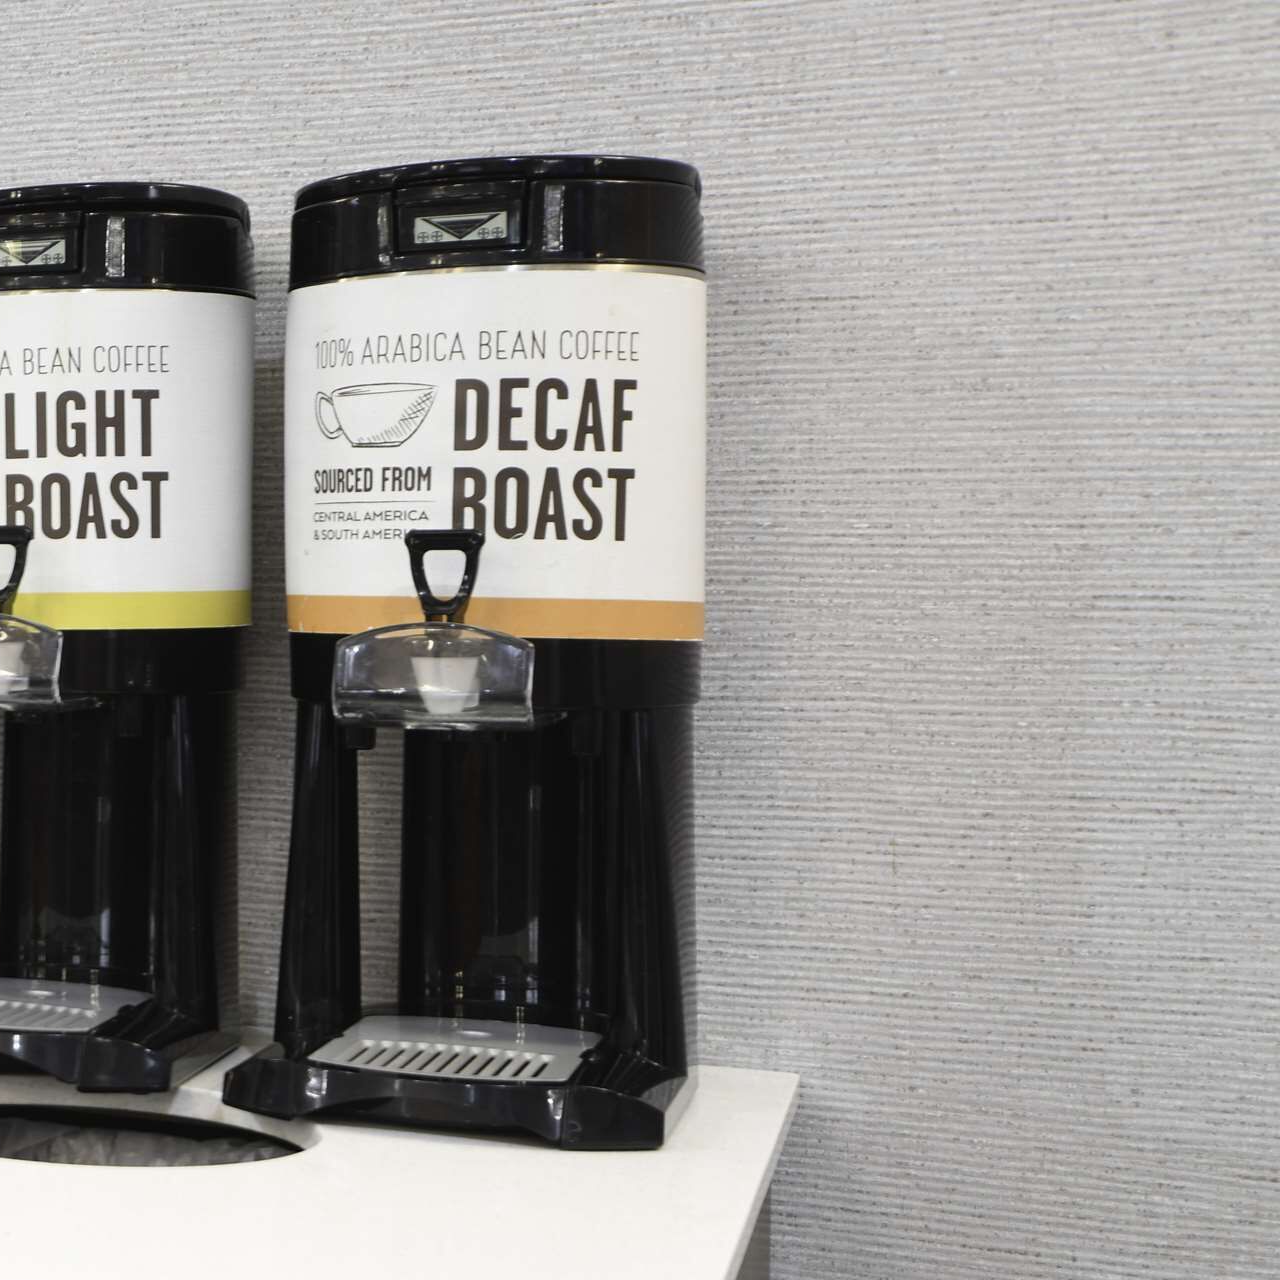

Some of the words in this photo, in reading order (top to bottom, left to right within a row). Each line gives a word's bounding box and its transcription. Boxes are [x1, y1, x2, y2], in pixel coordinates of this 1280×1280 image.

[23, 346, 83, 376] BEAN
[93, 345, 171, 374] COFFEE
[315, 337, 354, 369] 100%
[361, 332, 466, 366] ARABICA
[478, 330, 547, 361] BEAN
[559, 329, 640, 362] COFFEE
[4, 389, 160, 460] LIGHT
[453, 377, 638, 452] DECAF
[314, 467, 373, 494] SOURCED
[381, 465, 432, 492] FROM
[5, 471, 169, 540] ROAST
[312, 511, 361, 523] CENTRAL
[363, 509, 430, 522] AMERICA
[451, 466, 636, 542] ROAST
[321, 529, 360, 540] SOUTH
[362, 528, 406, 540] AMERI
